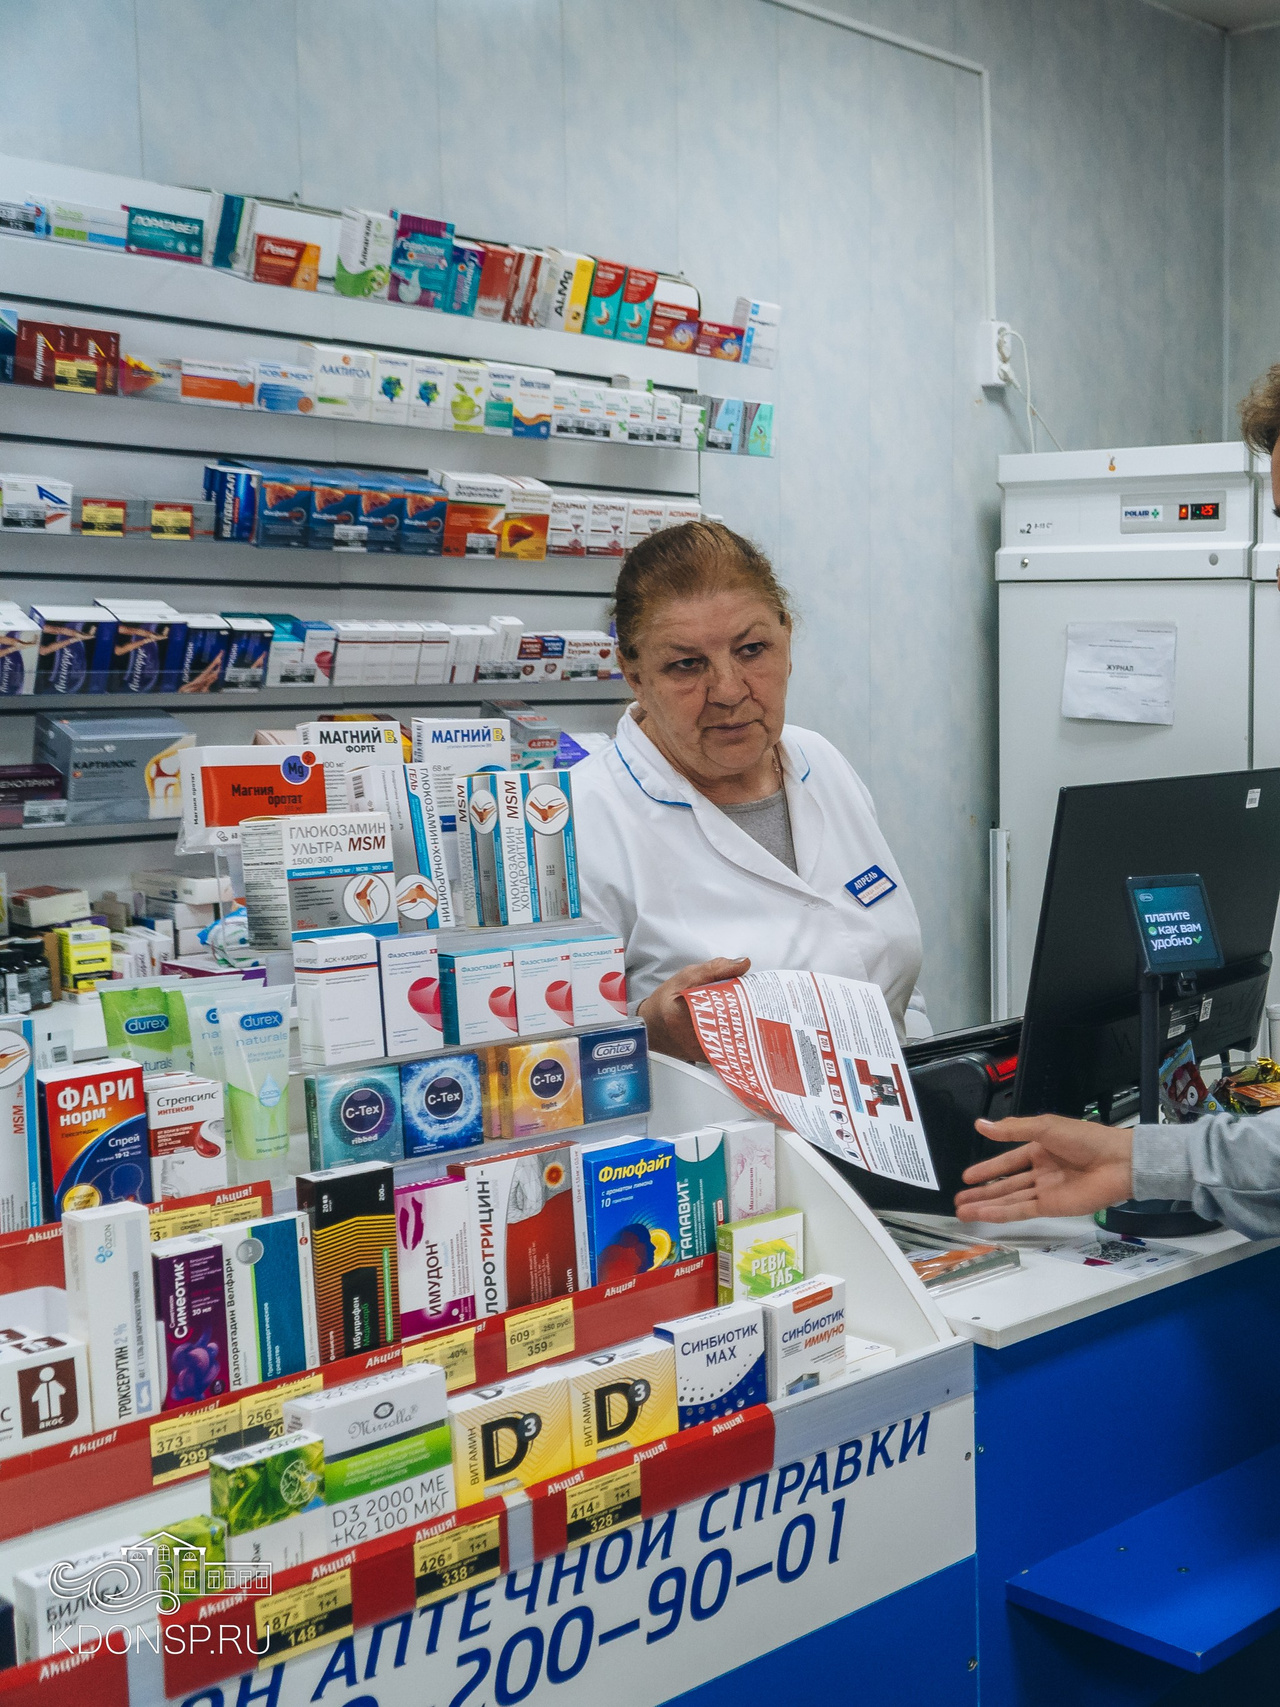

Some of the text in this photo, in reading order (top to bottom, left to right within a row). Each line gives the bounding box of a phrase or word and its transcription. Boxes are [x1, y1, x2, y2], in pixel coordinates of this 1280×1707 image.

[1106, 664, 1135, 672] ЖУРНАЛ
[320, 727, 382, 744] МАГНИЙ
[431, 725, 491, 744] МАГНИЙ
[346, 744, 376, 754] ФОРТЕ
[288, 761, 305, 778] Mg
[408, 768, 419, 791] ГЕЛЬ
[231, 783, 274, 797] Магния
[267, 793, 303, 808] оротат
[505, 780, 519, 820] MSM
[459, 784, 468, 823] MSM
[289, 822, 387, 840] ГЛЮКОЗАМИН
[291, 835, 387, 857] УЛЬТРА MSM
[419, 768, 452, 923] ГЛЮКОЗАМИН ХОНДРОИТИН
[292, 855, 334, 866] 1500/300
[505, 826, 519, 913] ГЛЮКОЗАМИН
[515, 827, 531, 910] ХОНДРОИТИН
[853, 871, 879, 891] АПРЕЛЬ
[1144, 911, 1191, 924] платите
[1158, 923, 1202, 935] как вам
[1150, 934, 1193, 951] удобно
[127, 1016, 168, 1033] durex
[243, 1013, 281, 1029] durex
[236, 1031, 288, 1048] naturals
[594, 1040, 634, 1060] Contex
[688, 989, 744, 1090] ПАМЯТКА
[820, 1037, 830, 1049] 102
[532, 1072, 563, 1087] C-Tex
[597, 1063, 634, 1077] Long Love
[57, 1077, 135, 1112] ФАРИ
[156, 1091, 217, 1108] Стрепсилс
[427, 1091, 461, 1105] C-Tex
[12, 1104, 24, 1135] MSM
[60, 1107, 106, 1128] норм
[157, 1104, 195, 1116] ИНТЕНСИВ
[346, 1103, 380, 1119] C-Tex
[108, 1134, 140, 1148] Спрей
[352, 1132, 378, 1146] ribbed
[598, 1153, 673, 1184] Флюфайт
[215, 1188, 253, 1206] Акция!
[600, 1197, 612, 1208] 10
[677, 1181, 693, 1261] ГАЛАВИТ
[104, 1223, 113, 1249] OZON
[674, 1259, 704, 1279] Акция!
[751, 1251, 787, 1278] РЕВИ
[426, 1243, 443, 1317] ИМУДОН
[604, 1278, 637, 1298] Акция!
[769, 1265, 795, 1290] ТАБ
[173, 1261, 188, 1340] Симеотик
[224, 1257, 242, 1387] Дезлоратадин Велфарм
[352, 1296, 362, 1350] Ибупрофен
[781, 1308, 845, 1344] синбиотик
[510, 1329, 530, 1346] 609
[681, 1323, 758, 1357] СИНБИОТИК
[804, 1323, 845, 1350] иммуно
[527, 1341, 548, 1358] 359
[114, 1344, 133, 1420] ТРОКСЕРУТИН
[247, 1408, 273, 1426] 256
[585, 1391, 593, 1447] ВИТАМИН
[712, 1414, 744, 1435] Акция!
[70, 1430, 118, 1459] Акция!
[156, 1424, 227, 1454] 373 1+1
[179, 1449, 208, 1468] 299
[471, 1426, 481, 1486] ВИТАМИН
[633, 1441, 668, 1463] Акция!
[547, 1471, 585, 1497] Акция!
[332, 1486, 414, 1529] D3 2000
[374, 1506, 409, 1536] 100
[414, 1491, 450, 1521] МКГ
[570, 1489, 631, 1520] 414 1+1
[415, 1516, 458, 1543] Акция!
[590, 1514, 613, 1533] 328
[311, 1550, 357, 1581] Акция!
[313, 1411, 930, 1700] АПТЕЧНОЙ СПРАВКИ
[420, 1539, 488, 1573] 426 1+1
[442, 1566, 468, 1588] 338
[317, 1595, 338, 1612] 1+1
[287, 1627, 319, 1648] 148
